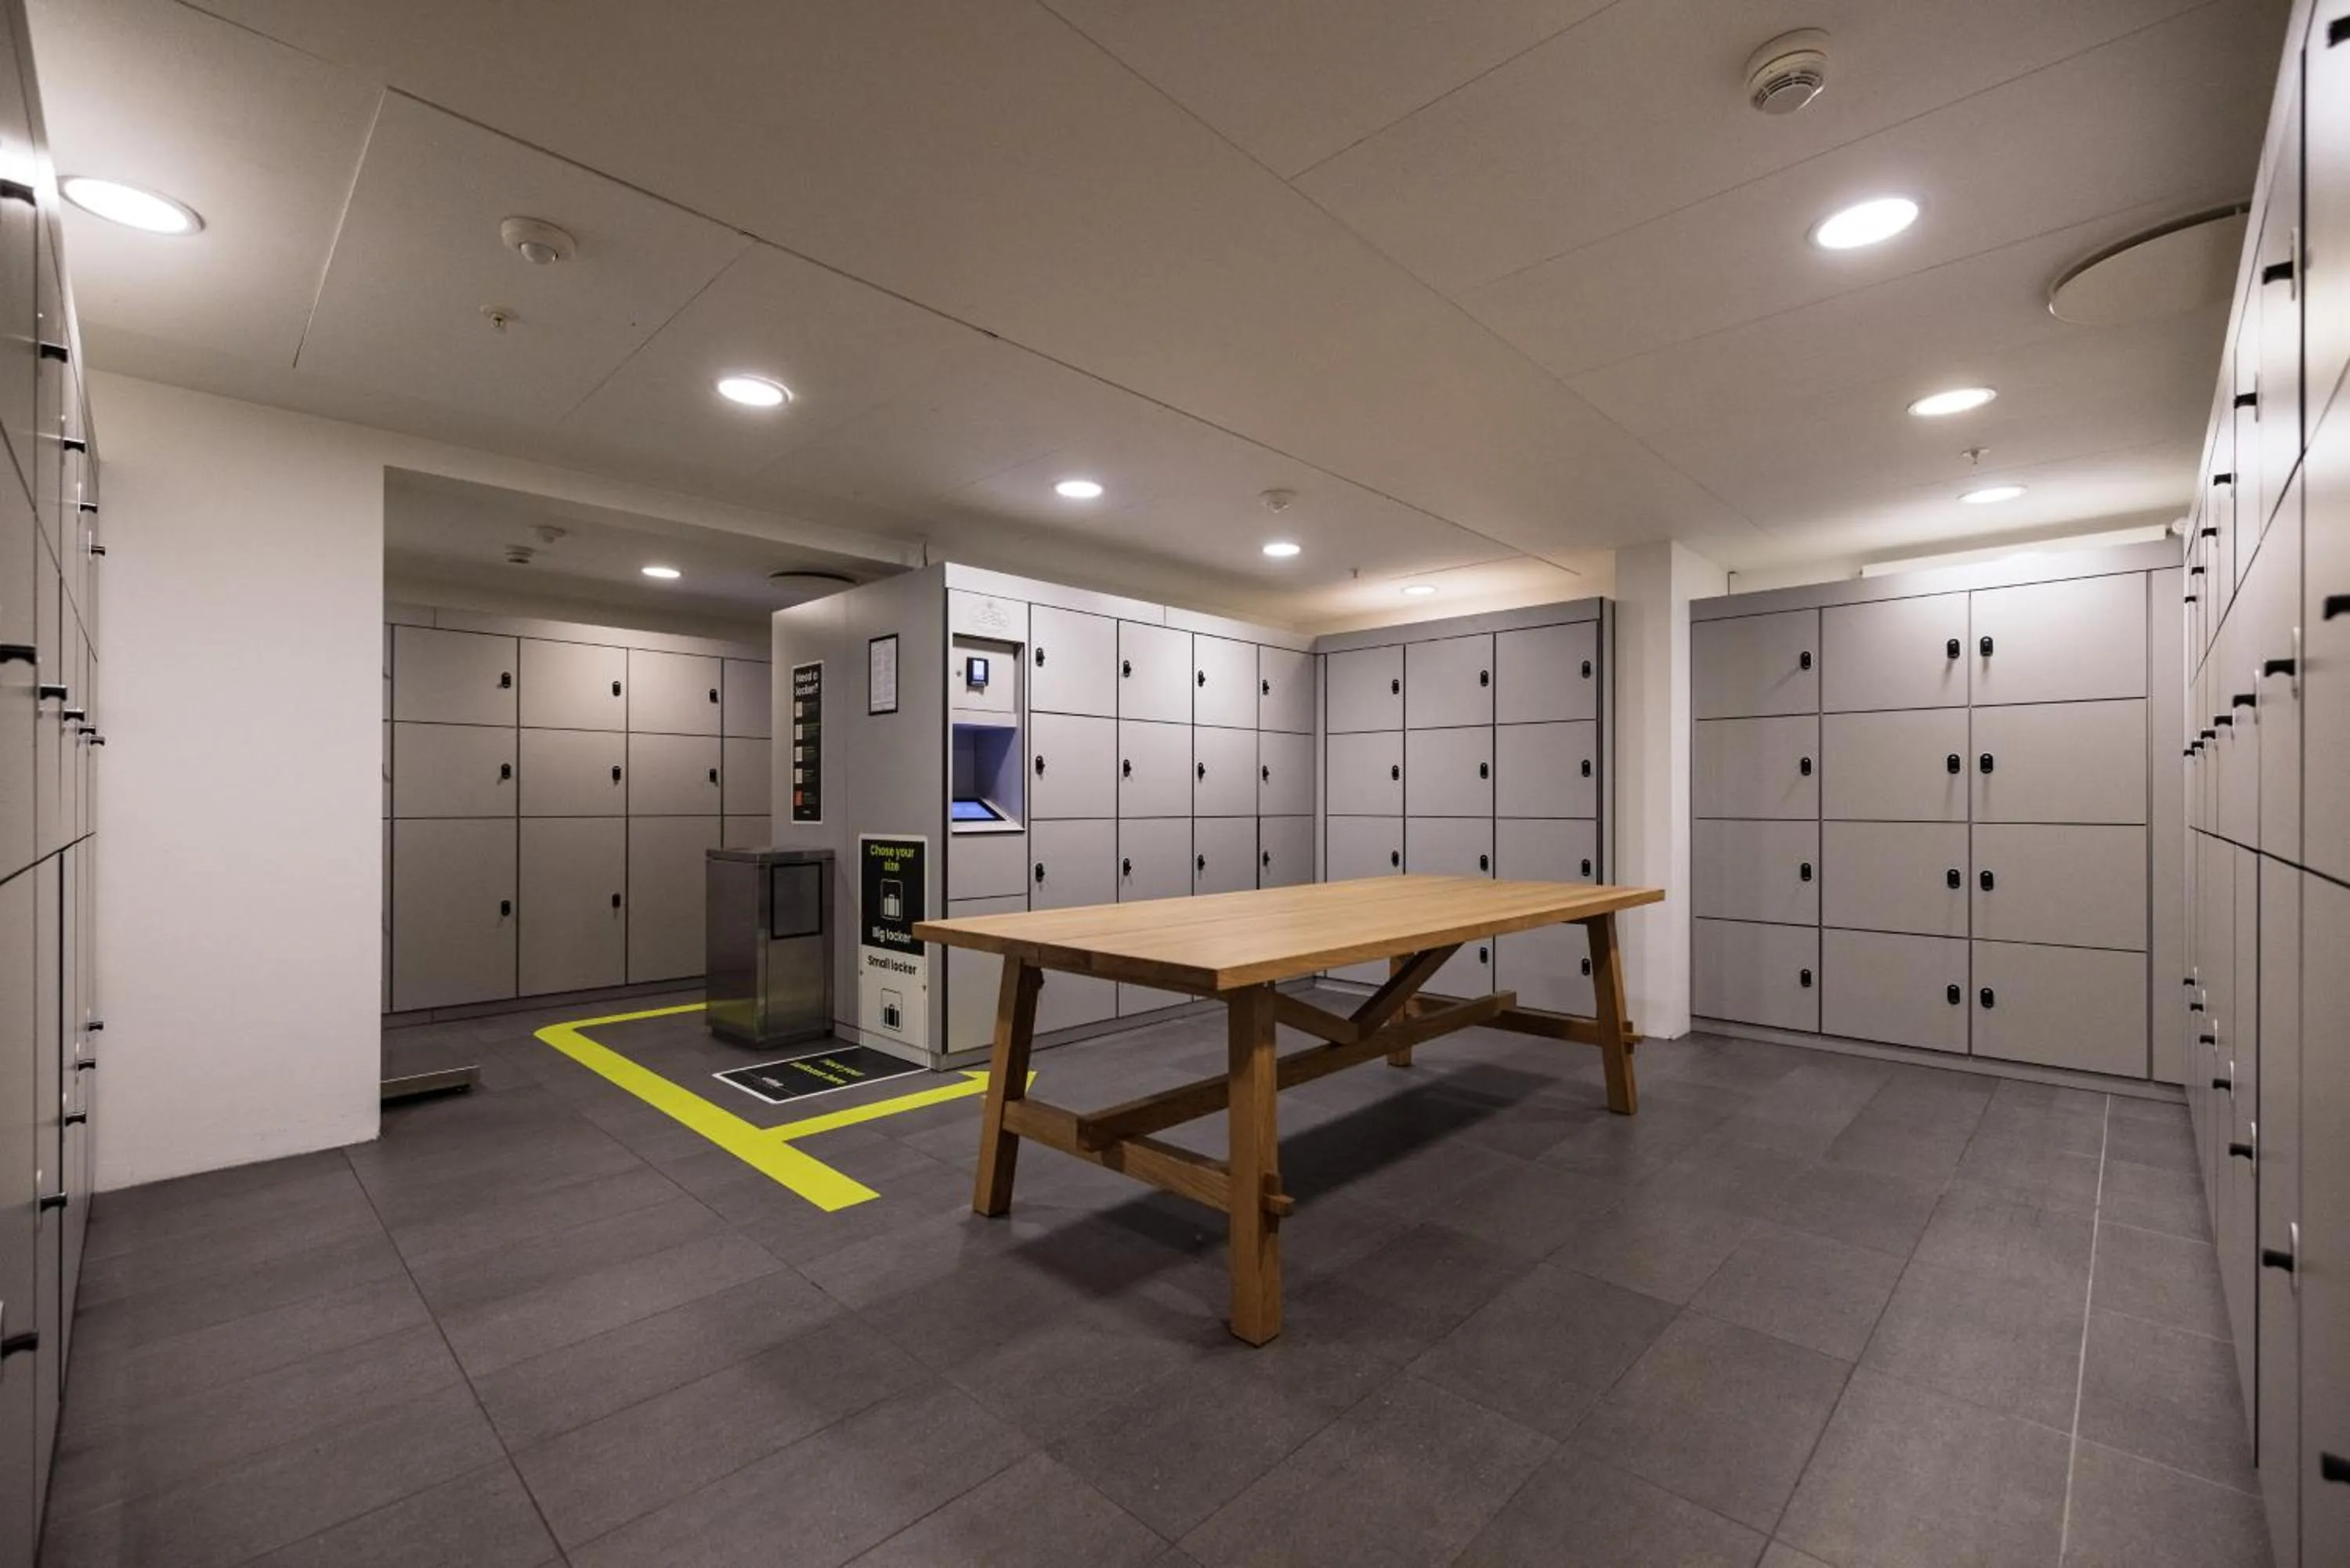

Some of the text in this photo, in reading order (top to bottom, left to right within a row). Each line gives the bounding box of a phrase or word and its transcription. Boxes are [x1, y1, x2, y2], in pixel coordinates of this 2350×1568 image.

[870, 844, 915, 861] Chose your
[884, 858, 900, 871] size
[886, 928, 912, 945] locker
[866, 955, 916, 976] Small locker
